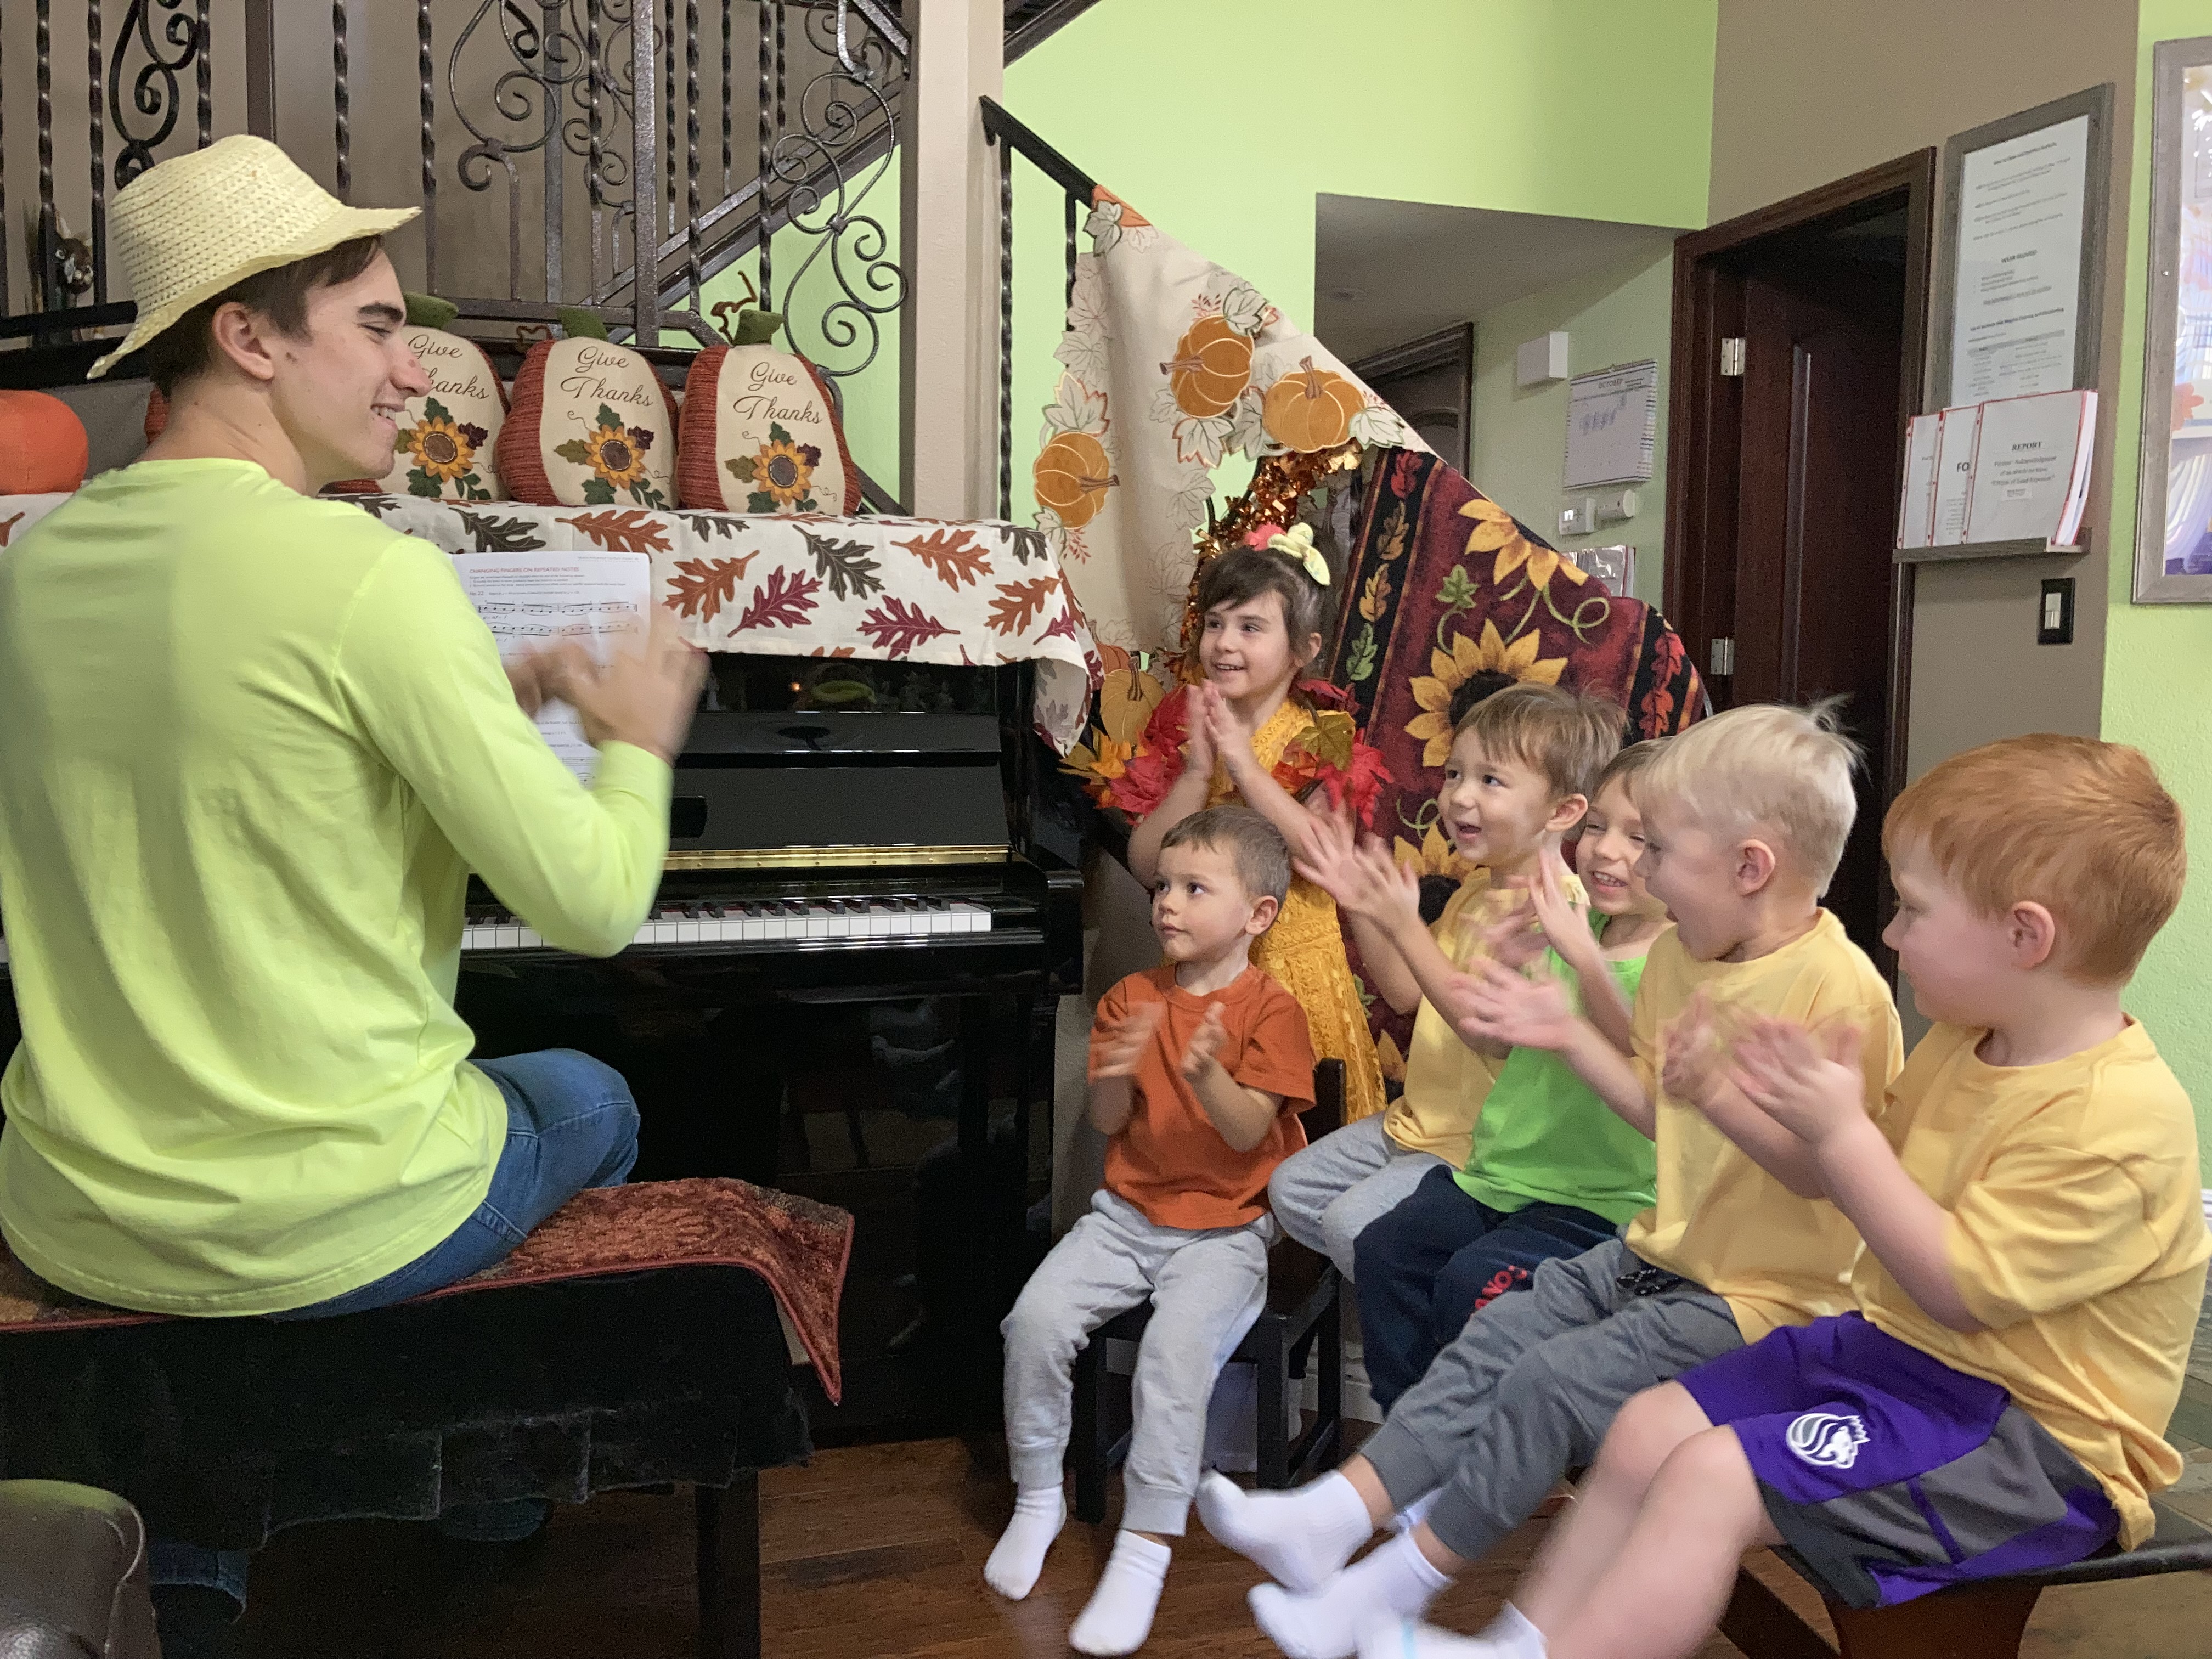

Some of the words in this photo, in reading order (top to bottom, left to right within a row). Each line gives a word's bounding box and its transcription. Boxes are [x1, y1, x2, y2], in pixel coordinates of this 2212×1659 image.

[408, 334, 463, 360] Give
[575, 346, 629, 373] Give
[748, 362, 798, 392] Give
[560, 376, 653, 407] Thanks
[733, 396, 823, 424] Thanks
[2012, 441, 2042, 450] REPORT
